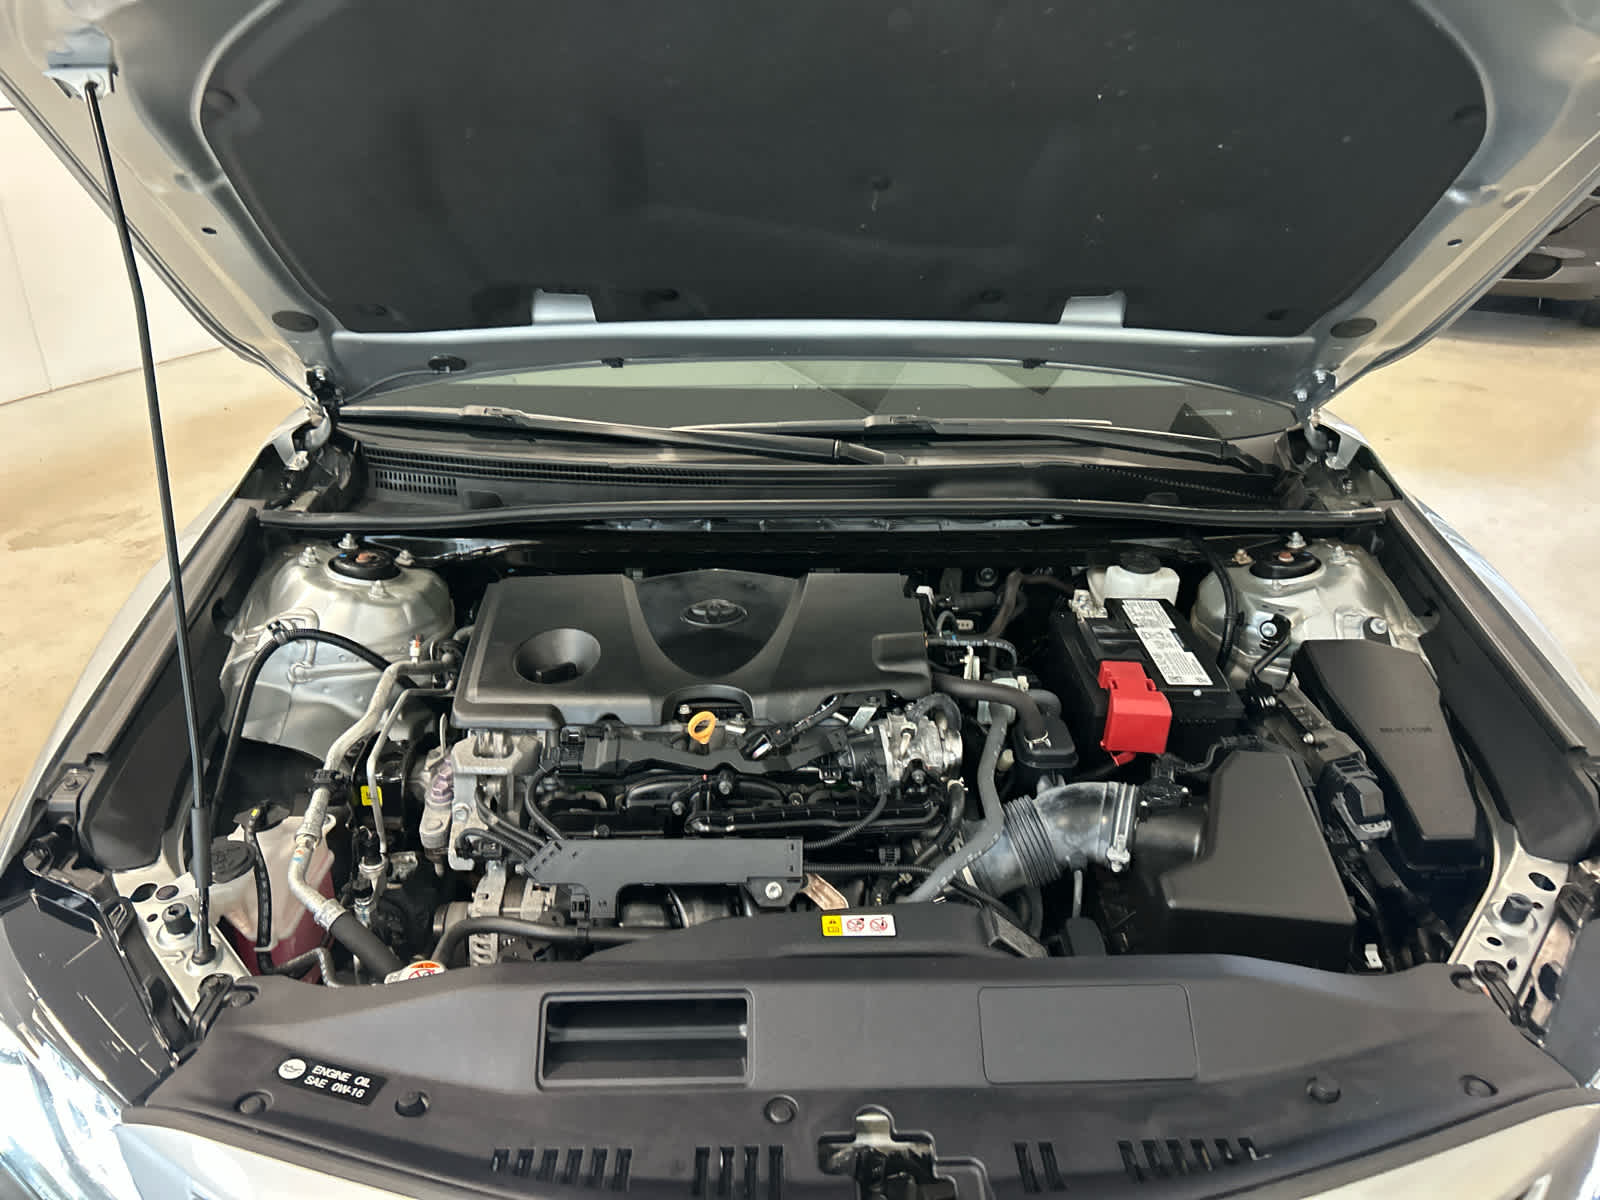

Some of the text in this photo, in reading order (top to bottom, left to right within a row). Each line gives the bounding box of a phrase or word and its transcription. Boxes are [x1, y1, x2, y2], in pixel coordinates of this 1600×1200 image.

[304, 1075, 365, 1098] SAE 0W-16
[312, 1065, 371, 1088] ENGINE OIL
